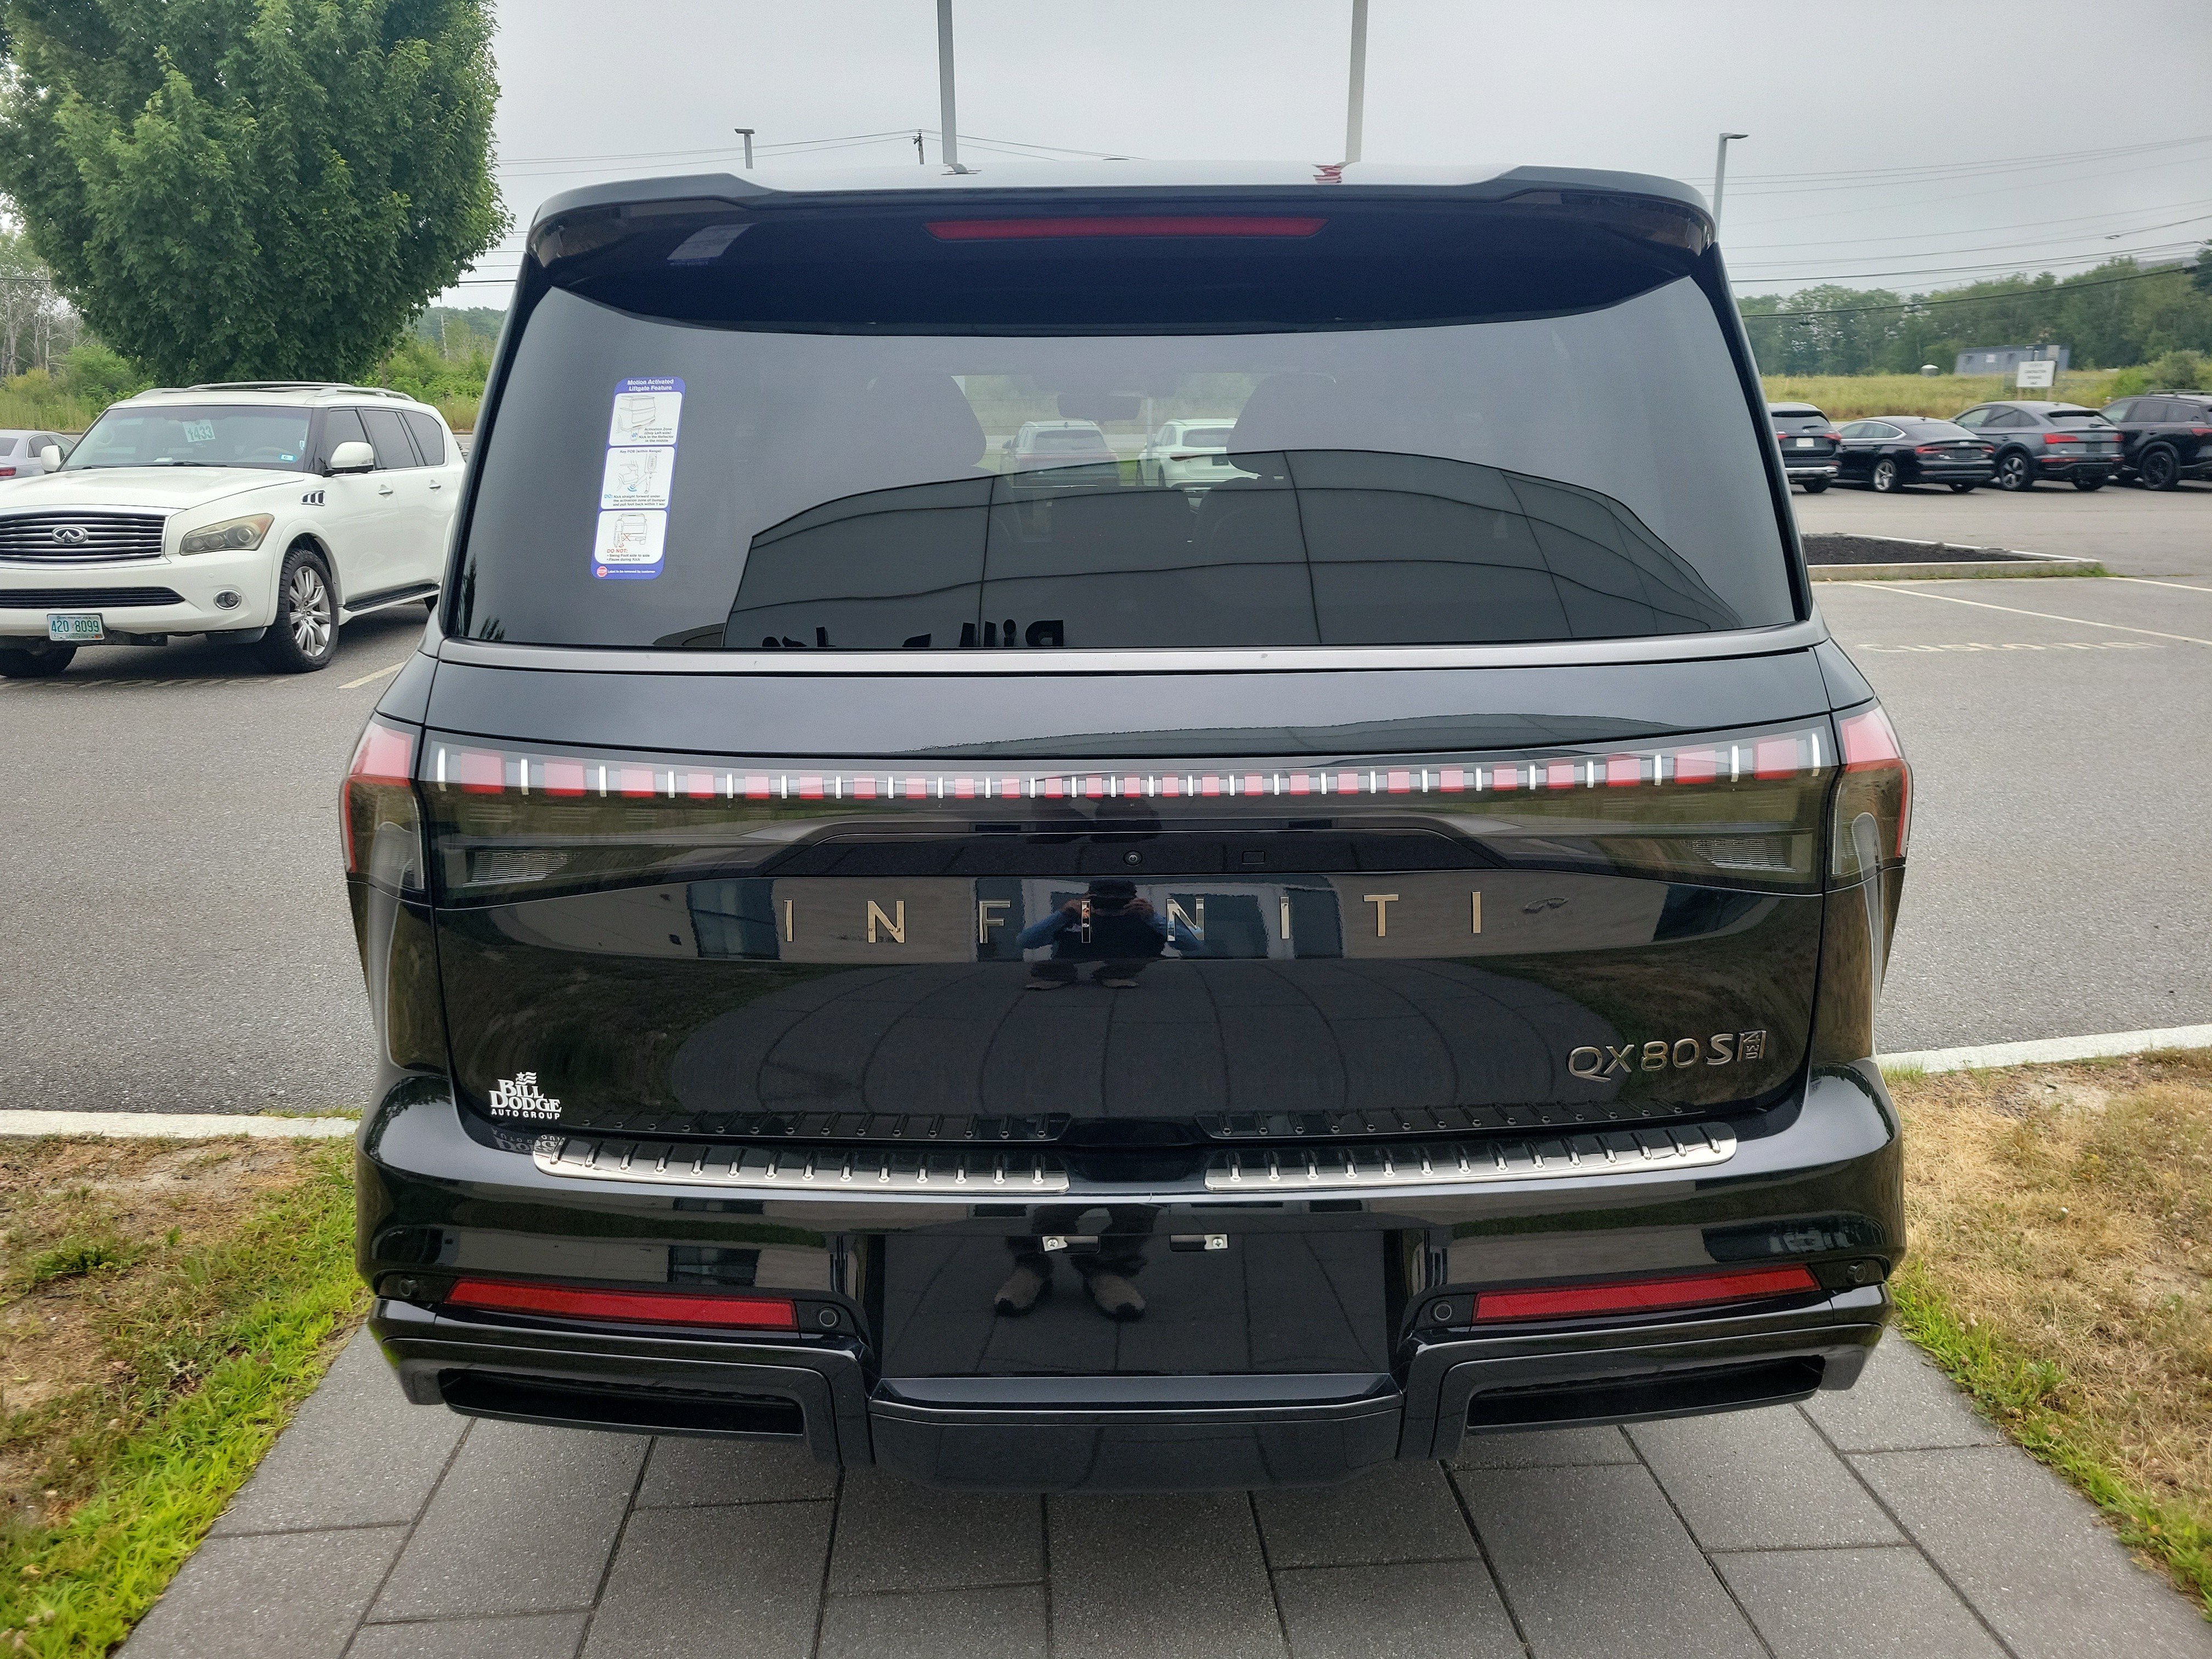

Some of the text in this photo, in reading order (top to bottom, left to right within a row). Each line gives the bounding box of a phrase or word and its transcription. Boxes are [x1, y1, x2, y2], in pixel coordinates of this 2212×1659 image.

[52, 620, 99, 632] 420 8099
[783, 891, 1482, 943] INFINITI
[497, 1079, 544, 1099] BILL
[488, 1090, 562, 1113] DODGE
[491, 1108, 561, 1120] AUTO GROUP
